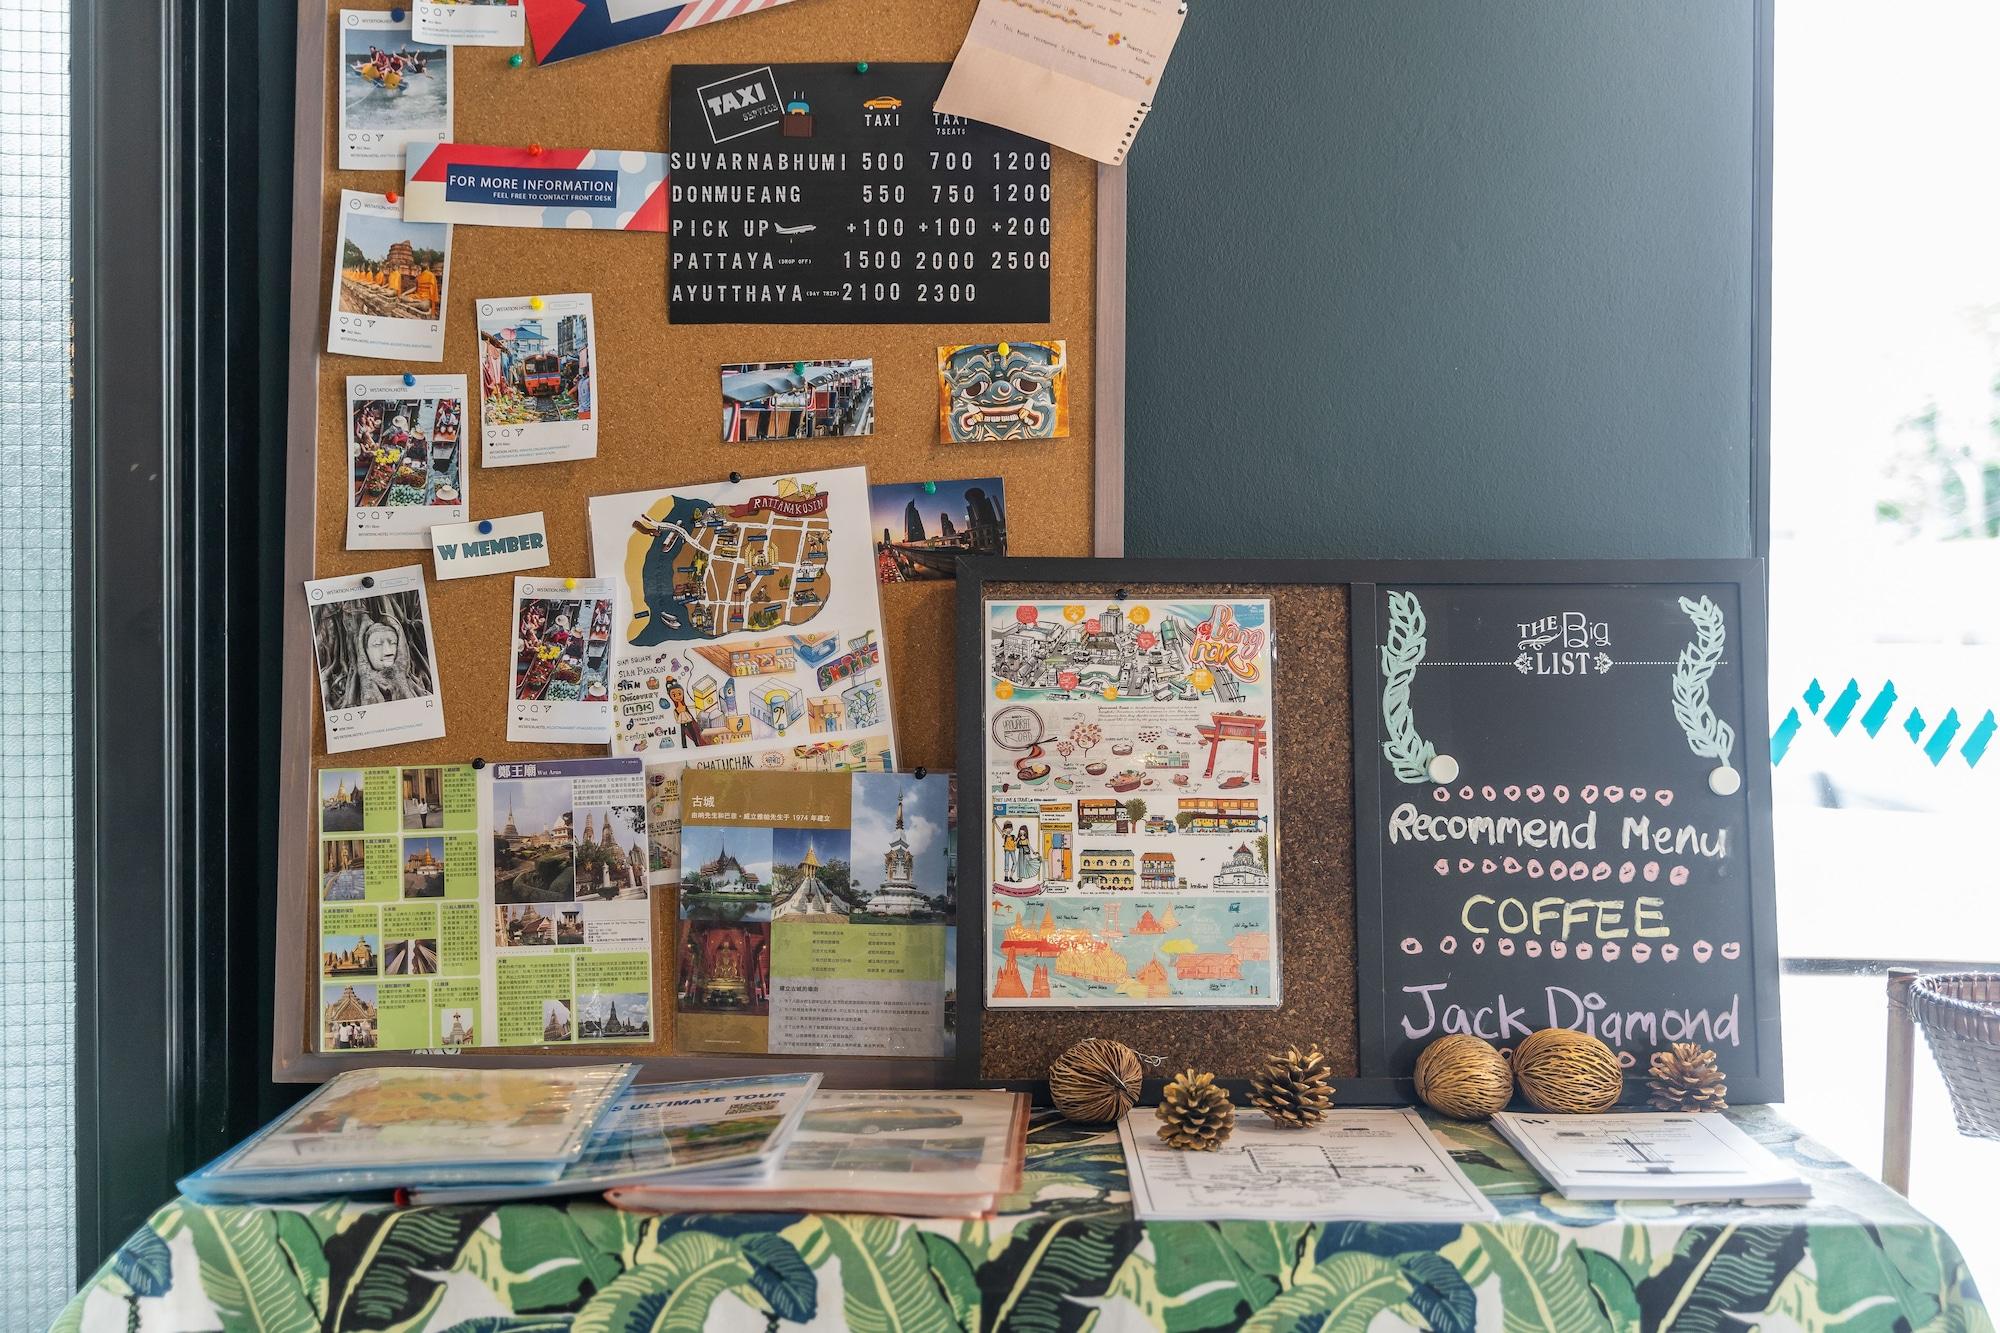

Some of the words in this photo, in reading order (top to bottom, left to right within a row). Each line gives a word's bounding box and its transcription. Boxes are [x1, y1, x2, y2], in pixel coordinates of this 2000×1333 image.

[707, 82, 767, 117] TAXI
[743, 103, 779, 122] SERVICE
[864, 113, 901, 127] TAXI
[671, 152, 847, 172] SUVARNABHUMI
[861, 153, 905, 171] 500
[929, 151, 973, 170] 700
[992, 151, 1051, 171] 1200
[449, 175, 476, 188] FOR
[480, 177, 519, 190] MORE
[523, 179, 614, 193] INFORMATION
[672, 185, 801, 203] DONMUEANG
[863, 185, 905, 203] 550
[932, 185, 975, 203] 750
[992, 184, 1050, 203] 1200
[493, 191, 509, 199] FEEL
[511, 192, 527, 200] FREE
[529, 192, 537, 200] TO
[538, 193, 568, 201] CONTACT
[672, 219, 729, 238] PICK
[744, 219, 770, 238] UP
[847, 219, 904, 237] +100
[918, 218, 976, 237] +100
[992, 218, 1050, 236] +200
[672, 253, 774, 271] PATTAYA
[843, 251, 902, 269] 1500
[916, 252, 975, 270] 2000
[991, 251, 1050, 269] 2500
[672, 285, 803, 303] AYUTTHAYA
[842, 283, 901, 302] 2100
[917, 284, 976, 302] 2300
[753, 498, 824, 515] RATTANAKOSIN
[437, 544, 457, 561] W
[462, 532, 544, 559] MEMBER
[1211, 604, 1265, 660] Bang
[1516, 615, 1558, 638] THE
[1562, 611, 1612, 648] Big
[618, 670, 635, 678] SIAM
[637, 666, 666, 676] PARAGON
[1536, 652, 1591, 675] LIST
[617, 681, 641, 691] SIAM
[498, 764, 537, 778] 鄭王廟
[691, 795, 715, 808] 古城
[1389, 803, 1597, 851] Recommend
[1622, 815, 1728, 858] Menu
[1460, 894, 1670, 941] COFFEE
[1401, 982, 1533, 1040] Jack
[1545, 986, 1740, 1047] Diamond
[630, 1095, 726, 1112] ULTIMATE
[733, 1092, 787, 1103] TOUR
